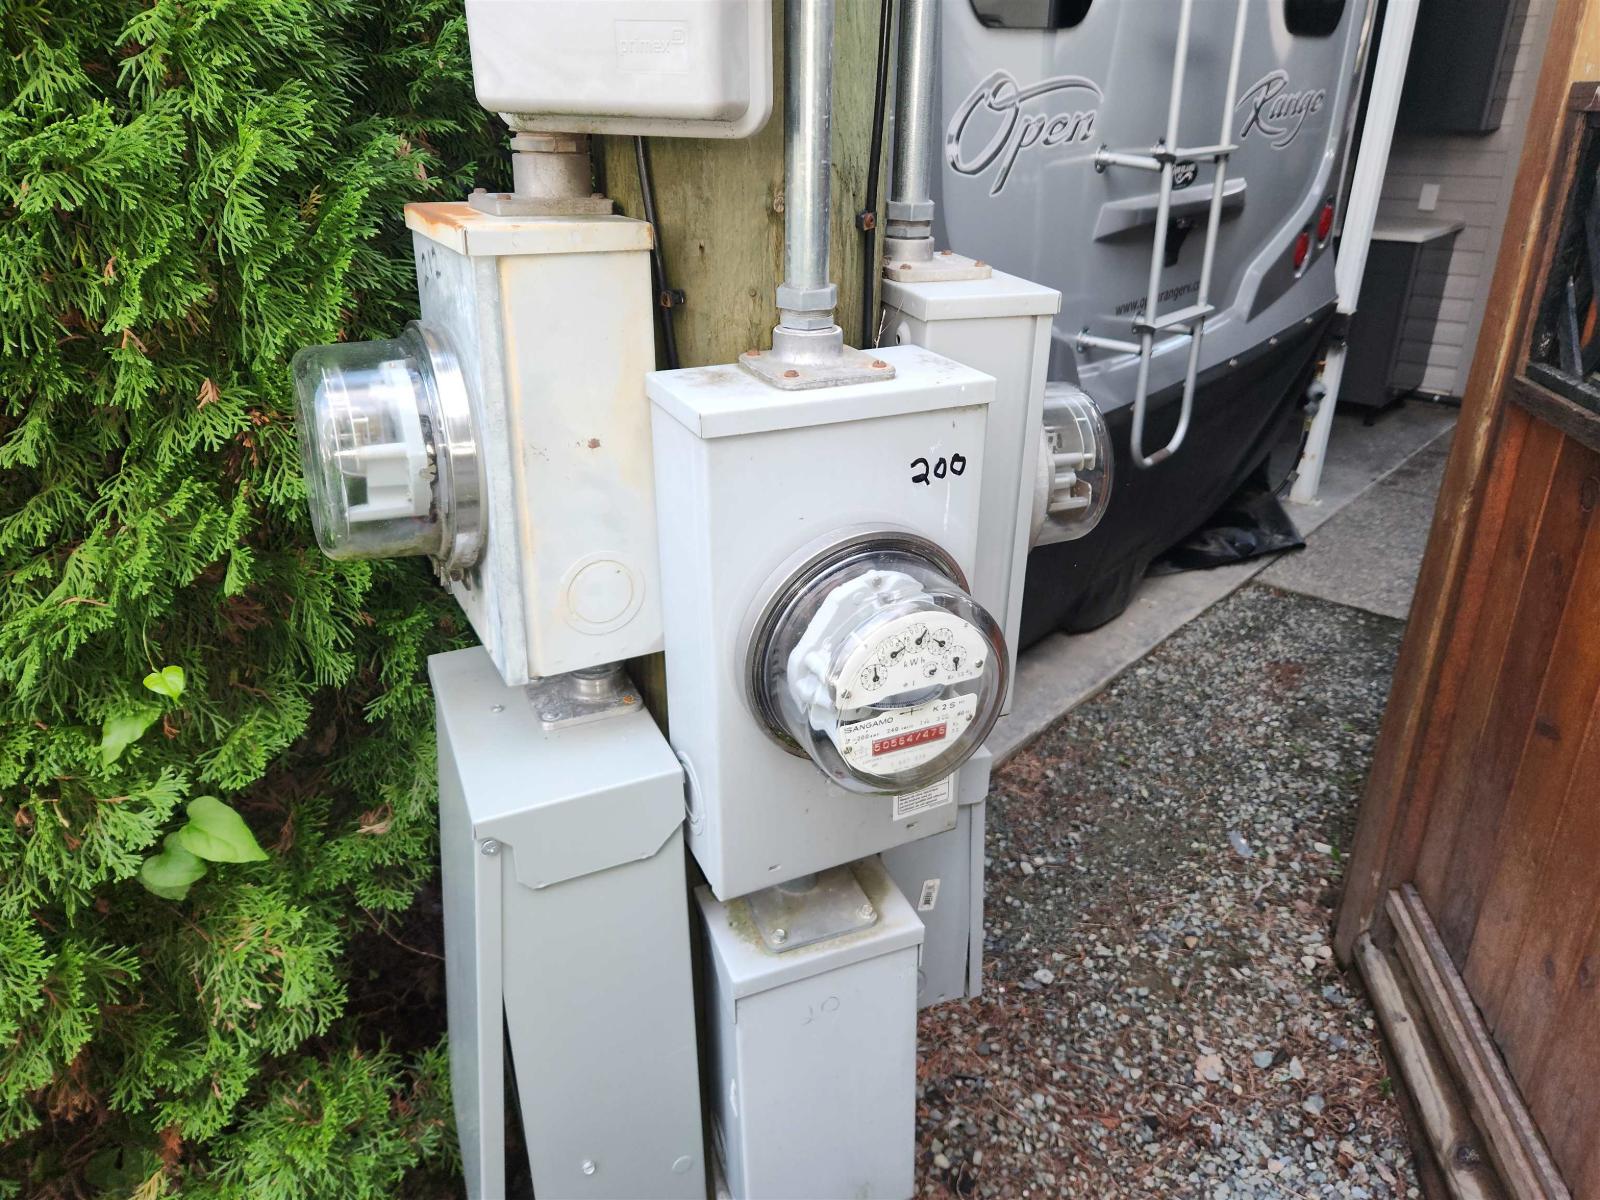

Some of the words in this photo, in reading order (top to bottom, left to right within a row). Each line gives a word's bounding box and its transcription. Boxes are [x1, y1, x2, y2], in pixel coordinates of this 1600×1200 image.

[945, 69, 1104, 196] Open
[1235, 69, 1326, 150] Range
[910, 453, 967, 486] 200
[843, 716, 894, 734] SANGAMO
